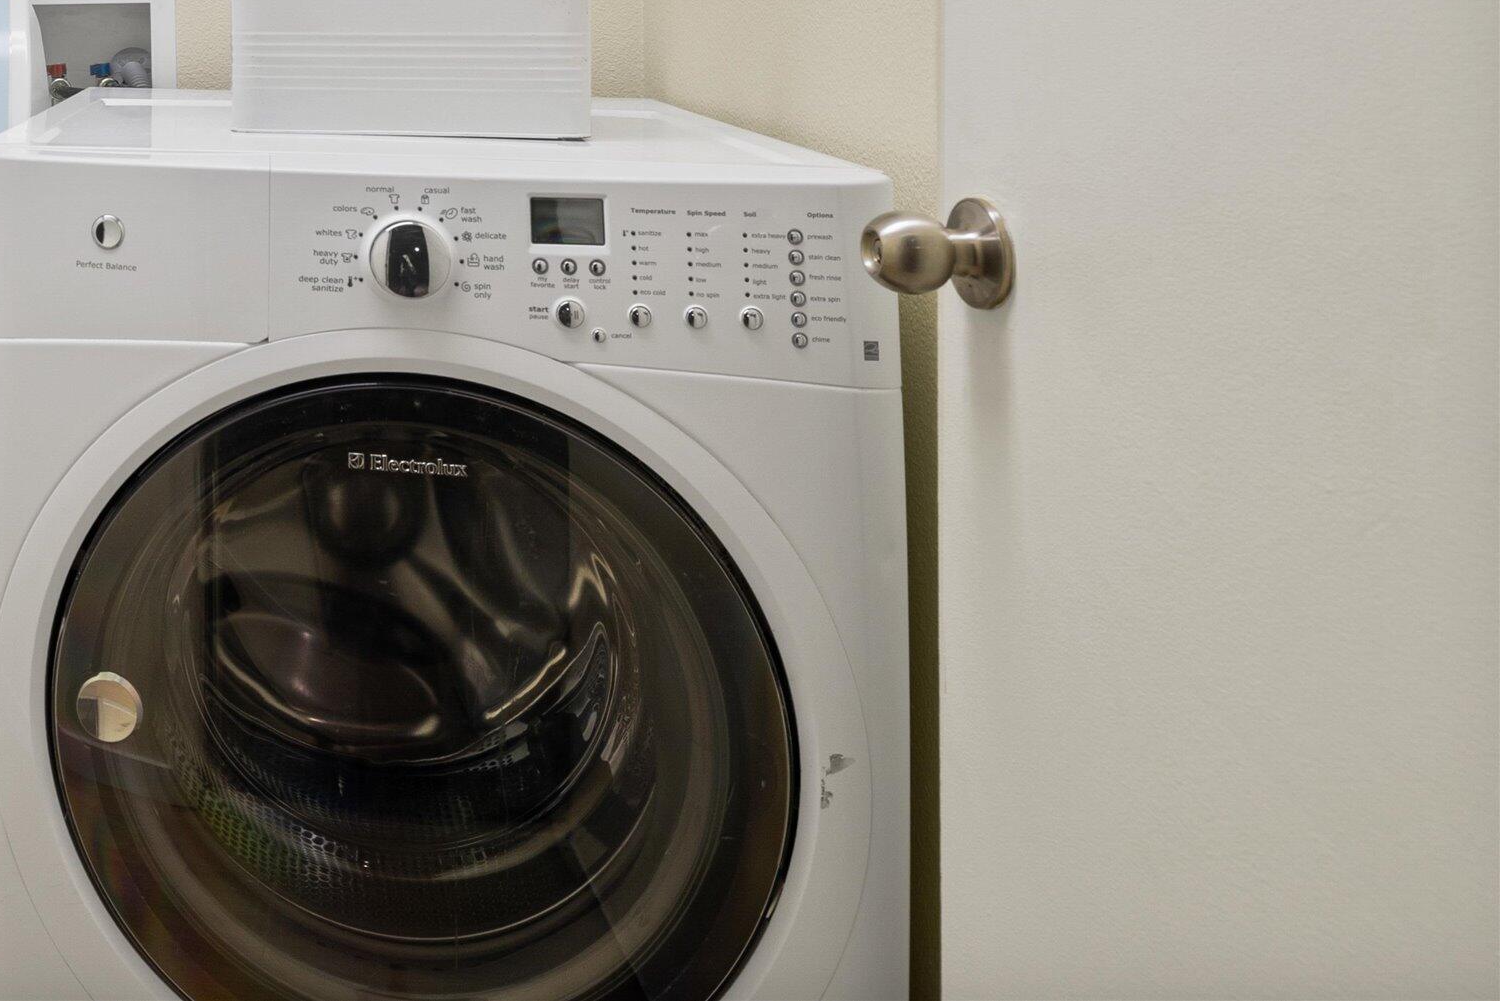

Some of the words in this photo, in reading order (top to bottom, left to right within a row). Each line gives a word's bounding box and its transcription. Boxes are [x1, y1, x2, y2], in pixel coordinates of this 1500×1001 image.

[631, 207, 676, 215] Temperature
[315, 229, 342, 237] whites
[312, 249, 338, 257] heavy
[76, 260, 103, 269] Perfect
[105, 262, 138, 271] Balance
[319, 258, 338, 266] duty
[483, 263, 505, 271] wash
[298, 275, 319, 283] deep
[311, 284, 344, 292] sanitize
[474, 291, 491, 299] only
[771, 293, 786, 301] light
[369, 453, 468, 477] Electrolux
